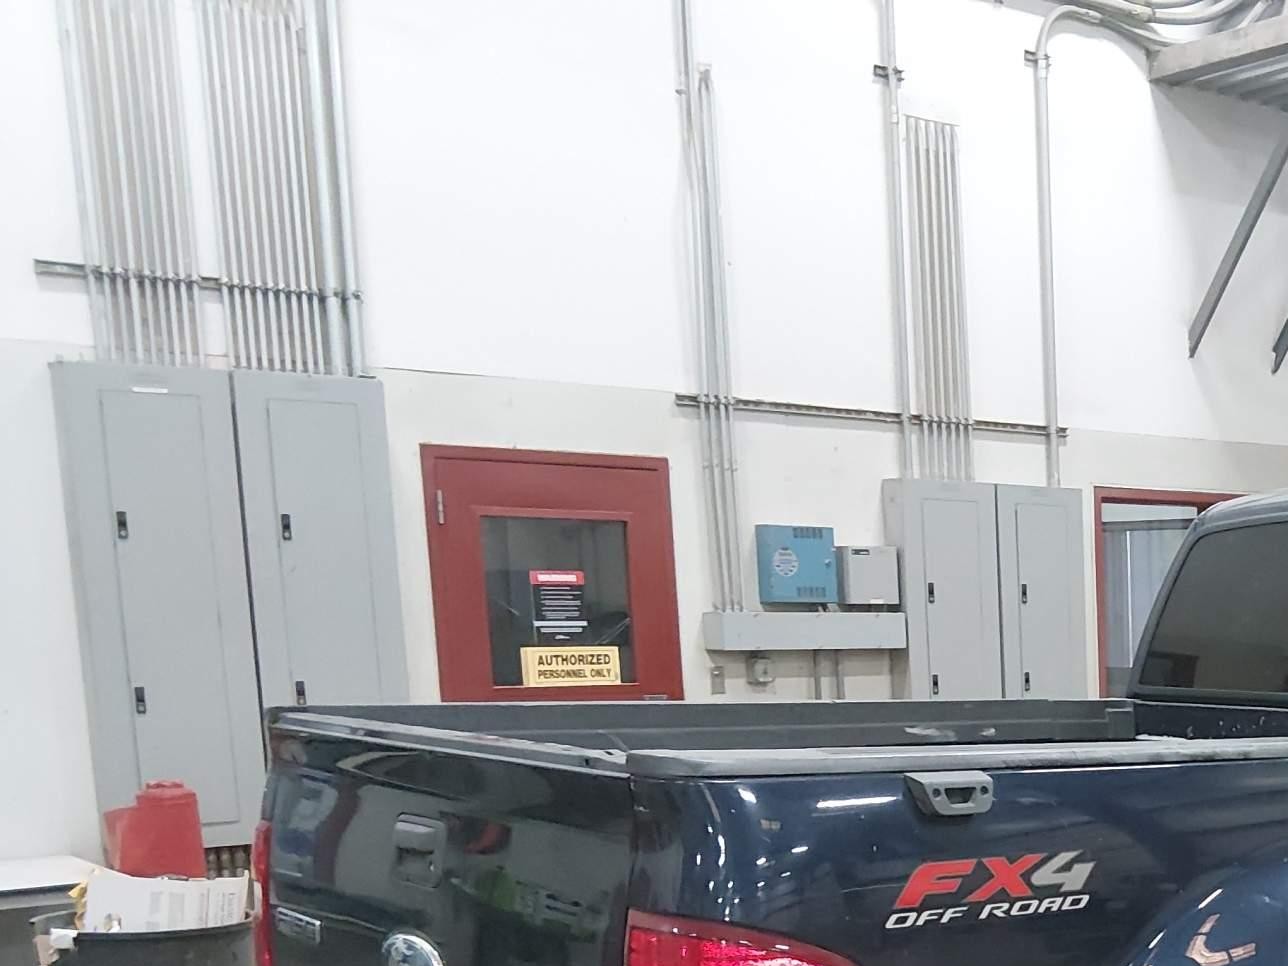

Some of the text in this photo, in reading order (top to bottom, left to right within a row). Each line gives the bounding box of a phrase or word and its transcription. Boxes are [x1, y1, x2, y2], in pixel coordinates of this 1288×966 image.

[537, 653, 612, 667] AUTHORIZED
[537, 667, 612, 680] PERSONNEL ONLY
[895, 850, 1097, 909] FX4
[884, 894, 1091, 929] OFF ROAD
